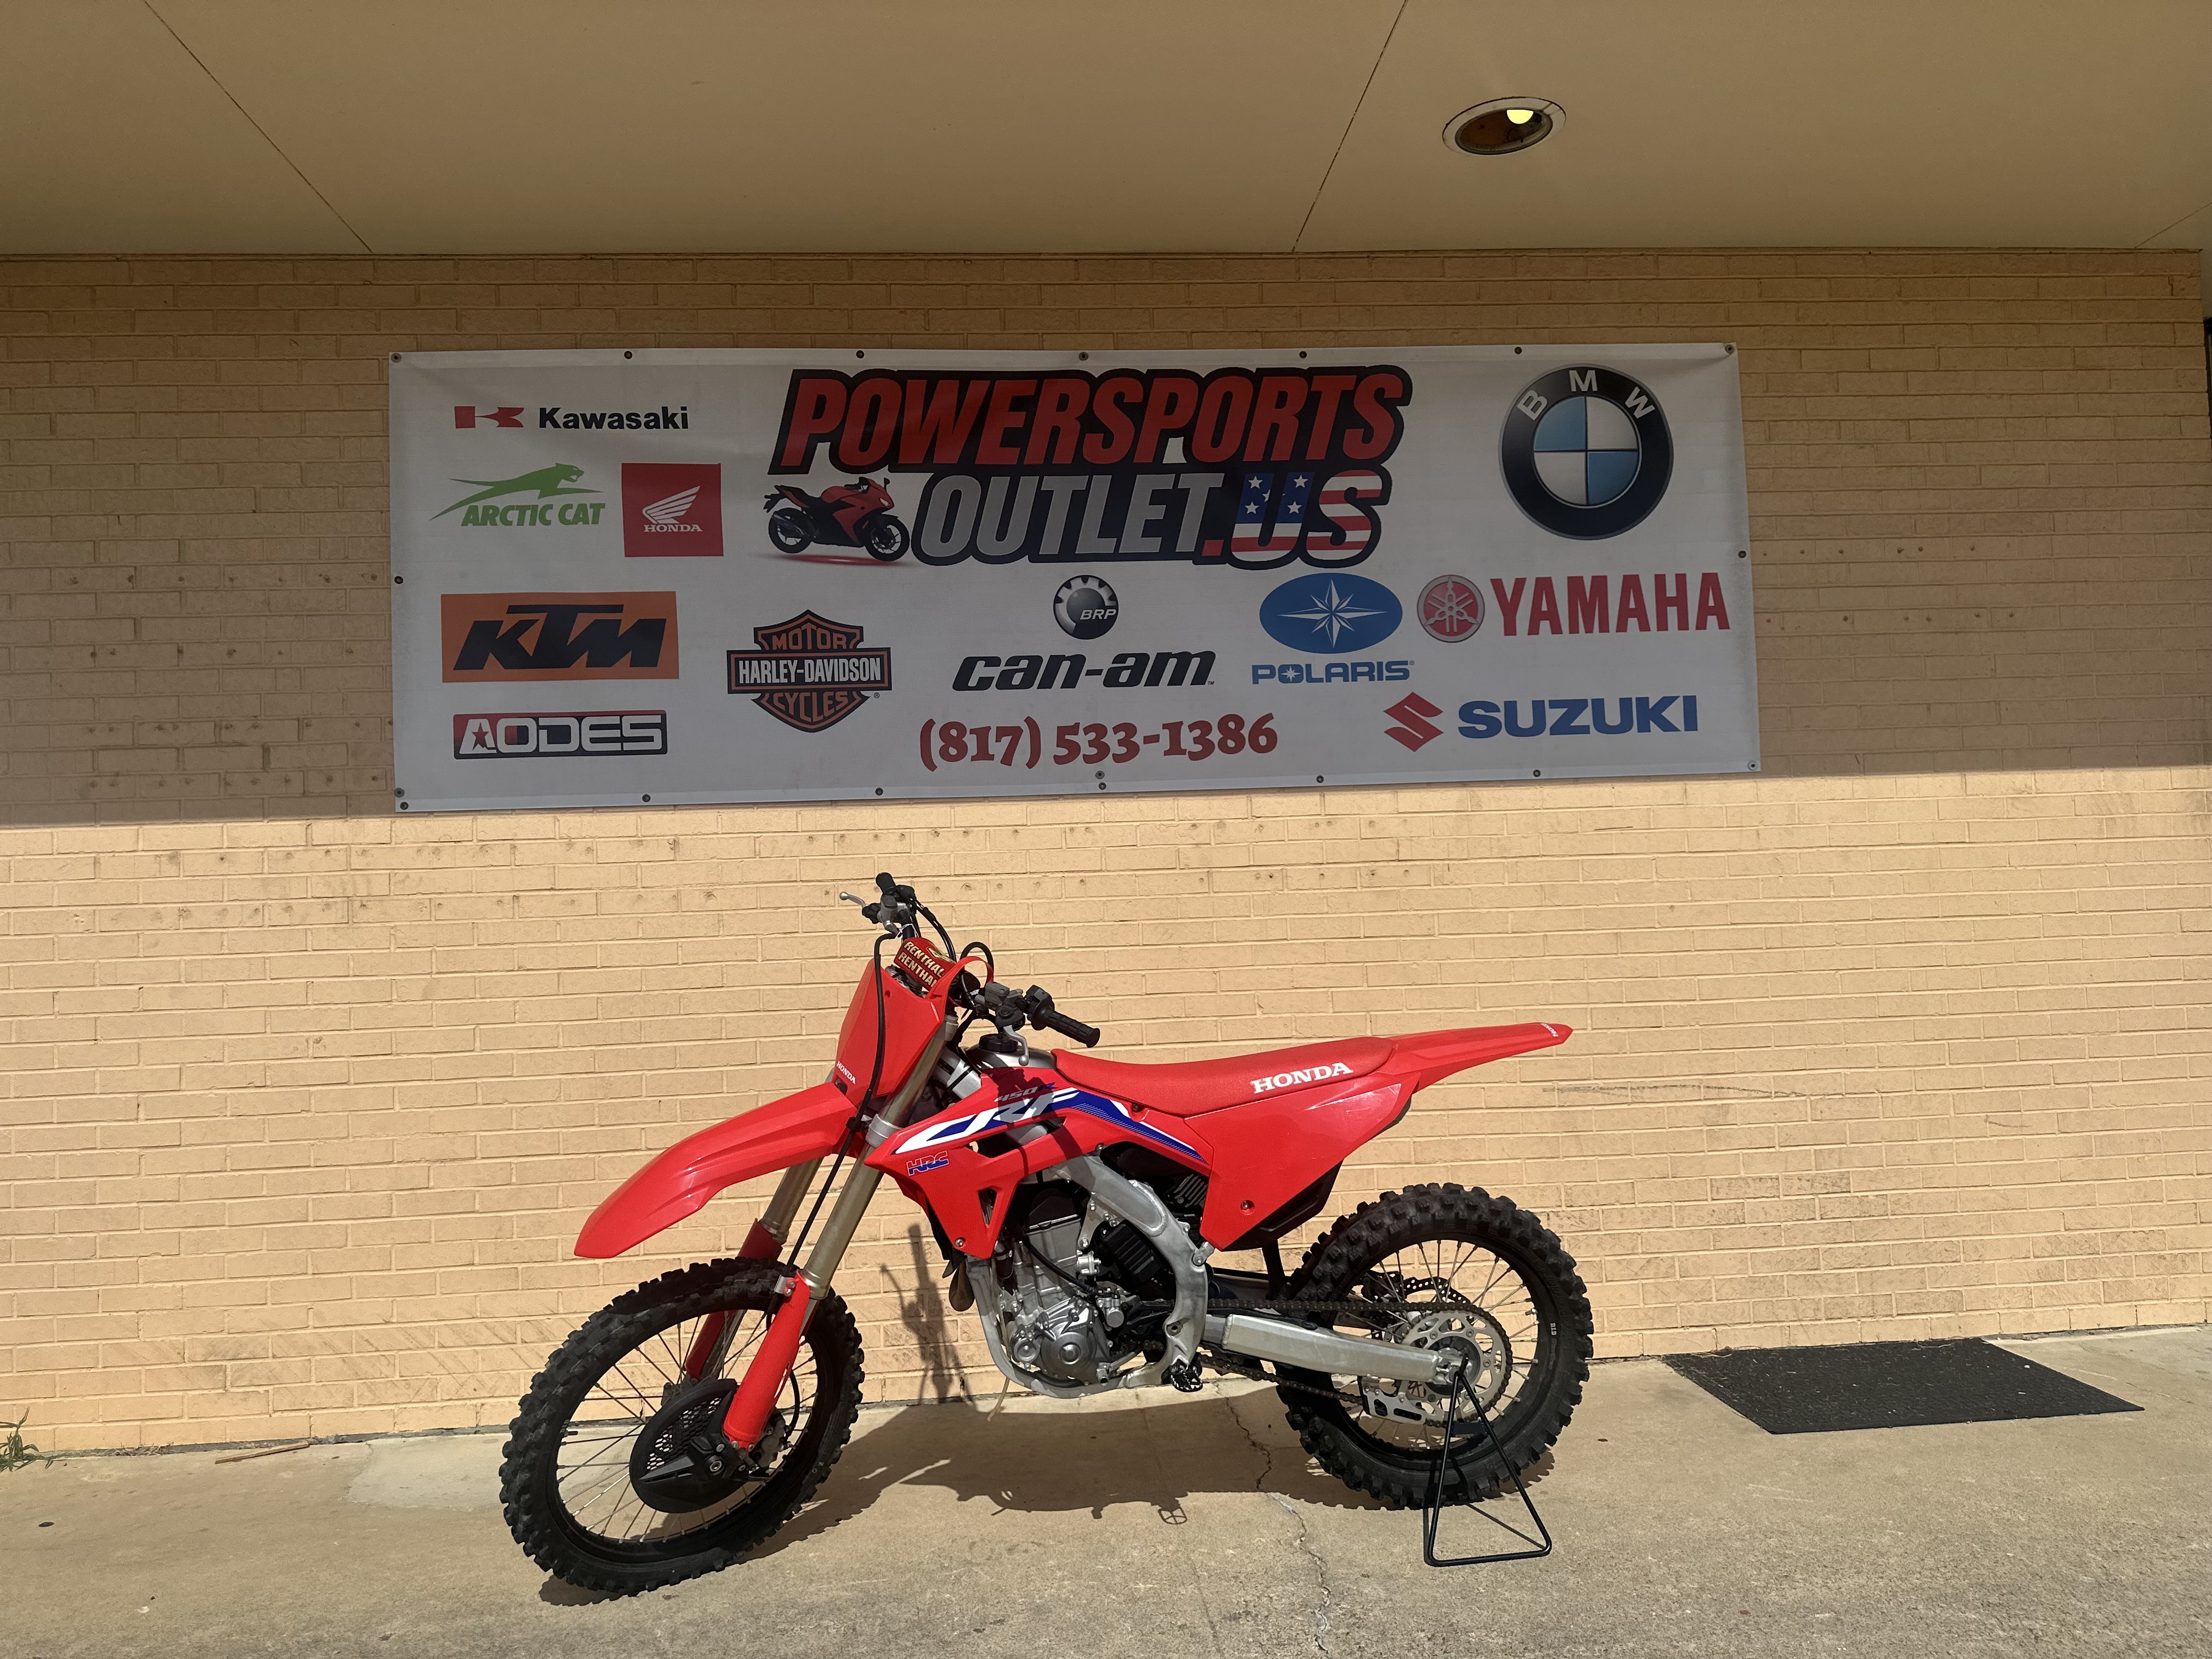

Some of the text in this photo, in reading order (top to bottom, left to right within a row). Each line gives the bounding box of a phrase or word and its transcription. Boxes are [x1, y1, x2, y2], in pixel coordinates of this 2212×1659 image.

[1517, 369, 1655, 420] BMW
[539, 406, 689, 430] Kawasaki
[778, 372, 1404, 467] POWERSPORTS
[461, 503, 606, 527] ARCTIC CAT
[644, 524, 703, 533] HONDA
[920, 470, 1383, 562] OUTLET.US
[1080, 609, 1117, 620] BRP
[1490, 572, 1731, 636] YAMAHA
[453, 604, 667, 670] KTM
[772, 622, 847, 650] MOTOR
[738, 657, 882, 684] HARLEY-DAVIDSON
[952, 651, 1216, 691] can-am
[1251, 660, 1410, 685] POLARIS
[772, 690, 849, 723] CYCLES
[1458, 695, 1698, 739] SUZUKI
[459, 714, 663, 755] AODES
[919, 713, 1278, 772] (817) 533-1386
[904, 941, 944, 978] RENTHAL
[836, 1060, 856, 1085] HONDA
[1250, 1062, 1354, 1094] HONDA
[906, 1150, 950, 1176] HRC
